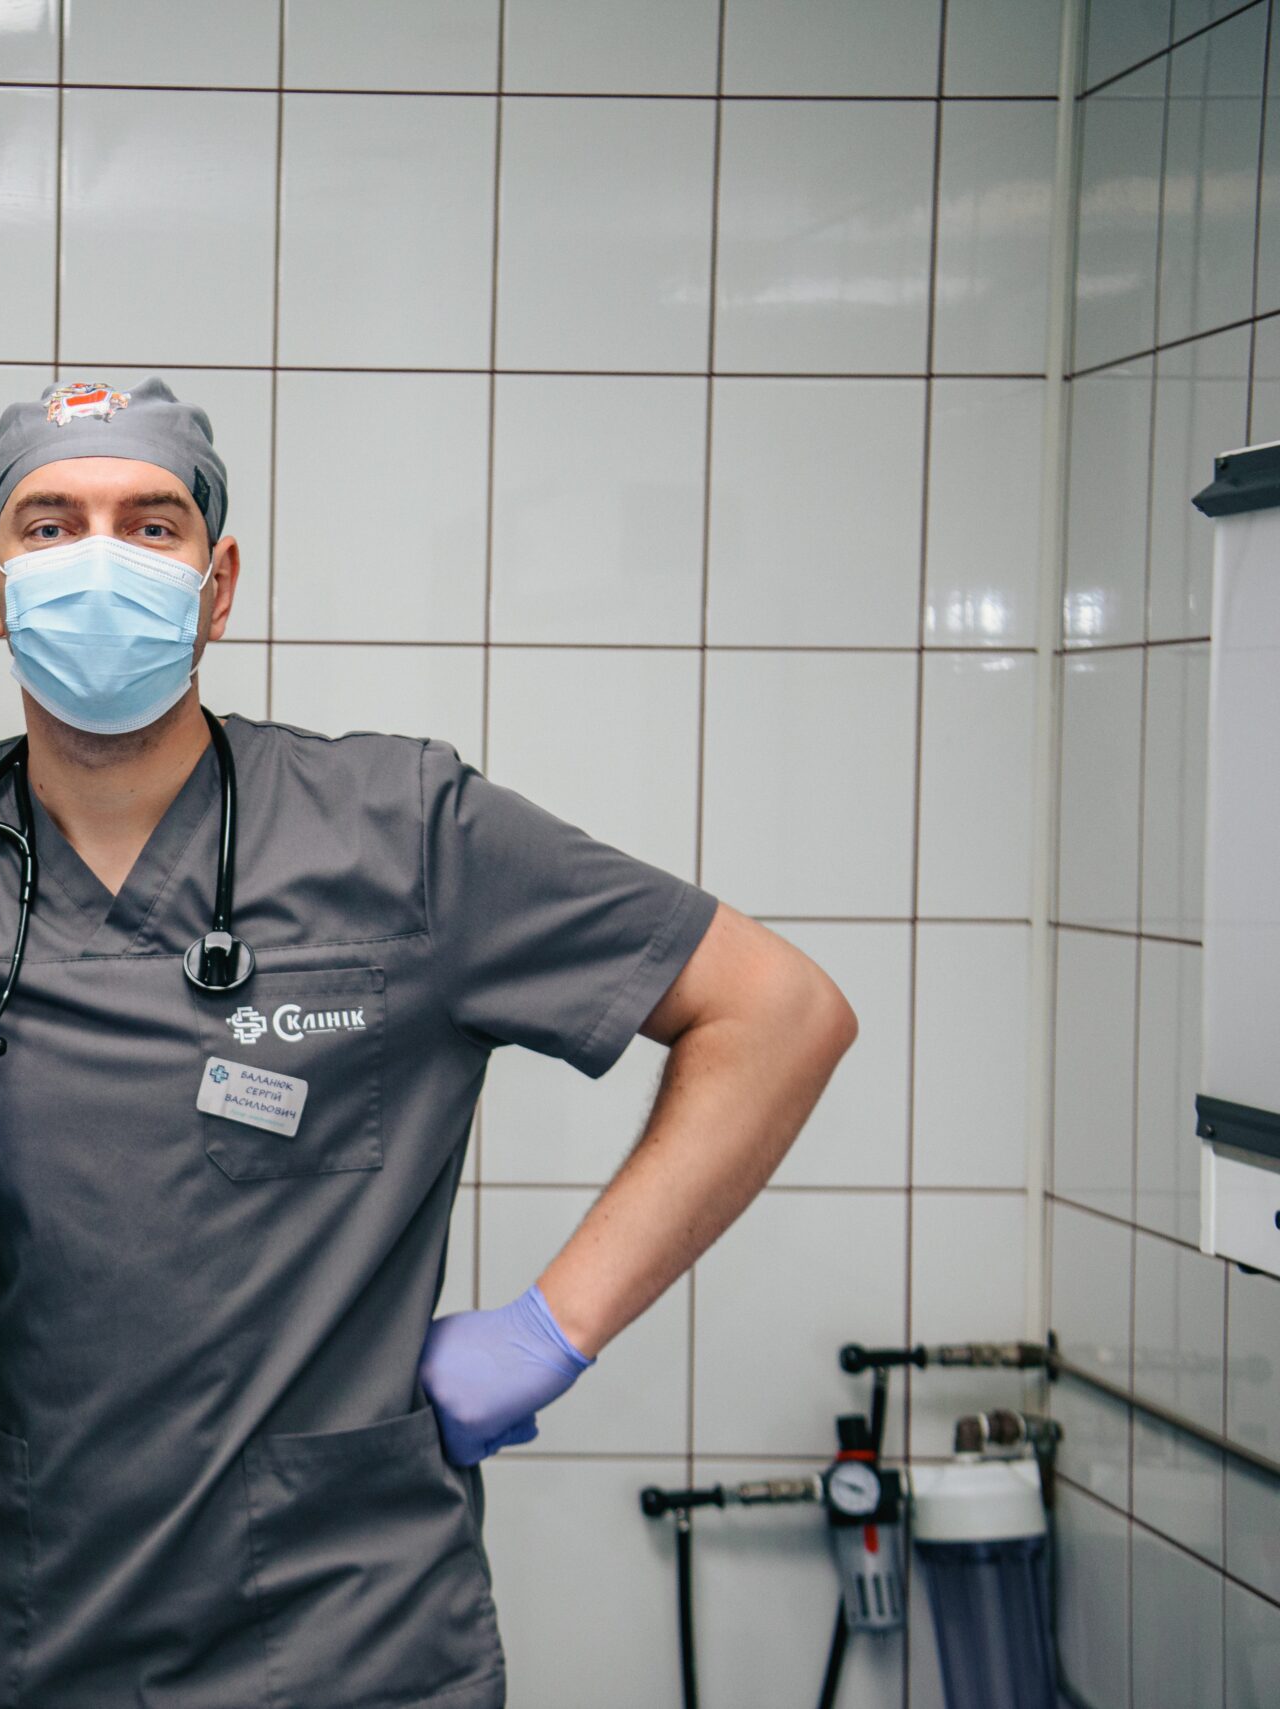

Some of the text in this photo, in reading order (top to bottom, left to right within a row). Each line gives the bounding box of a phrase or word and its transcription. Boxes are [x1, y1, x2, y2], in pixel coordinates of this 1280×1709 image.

[240, 1070, 294, 1092] БАЛАНЮК
[246, 1086, 282, 1102] СЕРГІЙ
[224, 1093, 297, 1120] ВАСИЛЬОВИЧ
